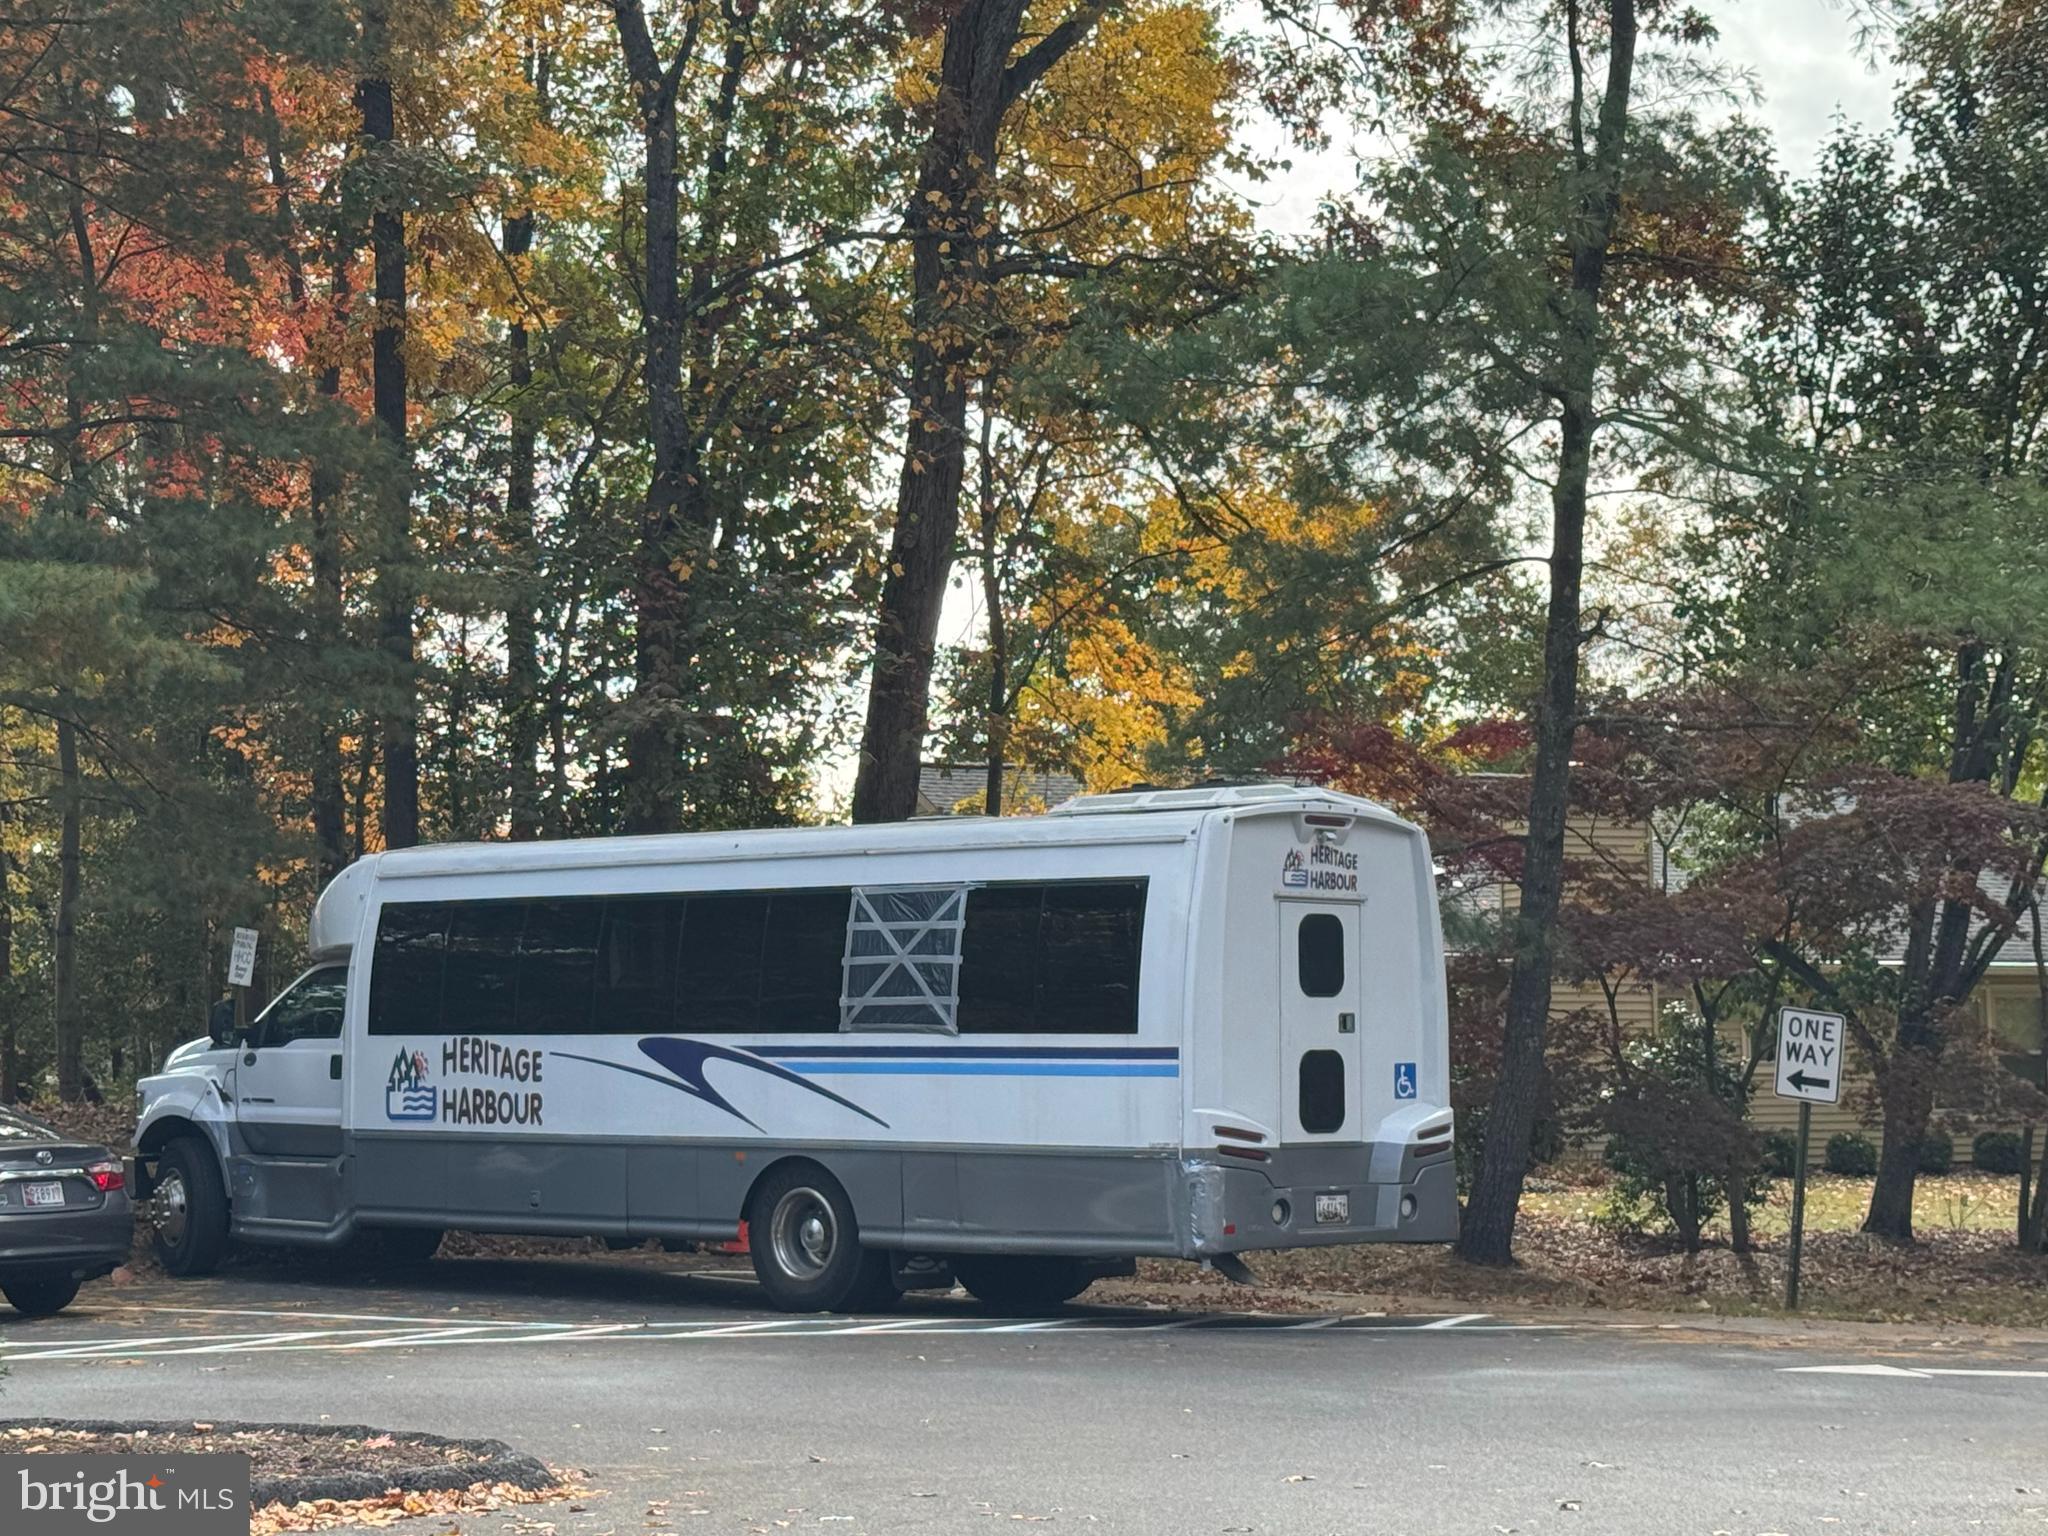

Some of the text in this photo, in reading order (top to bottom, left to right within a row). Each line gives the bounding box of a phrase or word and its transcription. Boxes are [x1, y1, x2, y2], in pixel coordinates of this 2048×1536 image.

[1310, 845, 1358, 870] HERITAGE
[1310, 870, 1358, 892] HARBOUR
[1788, 1016, 1835, 1042] ONE
[442, 1036, 543, 1082] HERITAGE
[1786, 1040, 1835, 1067] WAY
[442, 1086, 543, 1126] HARBOUR
